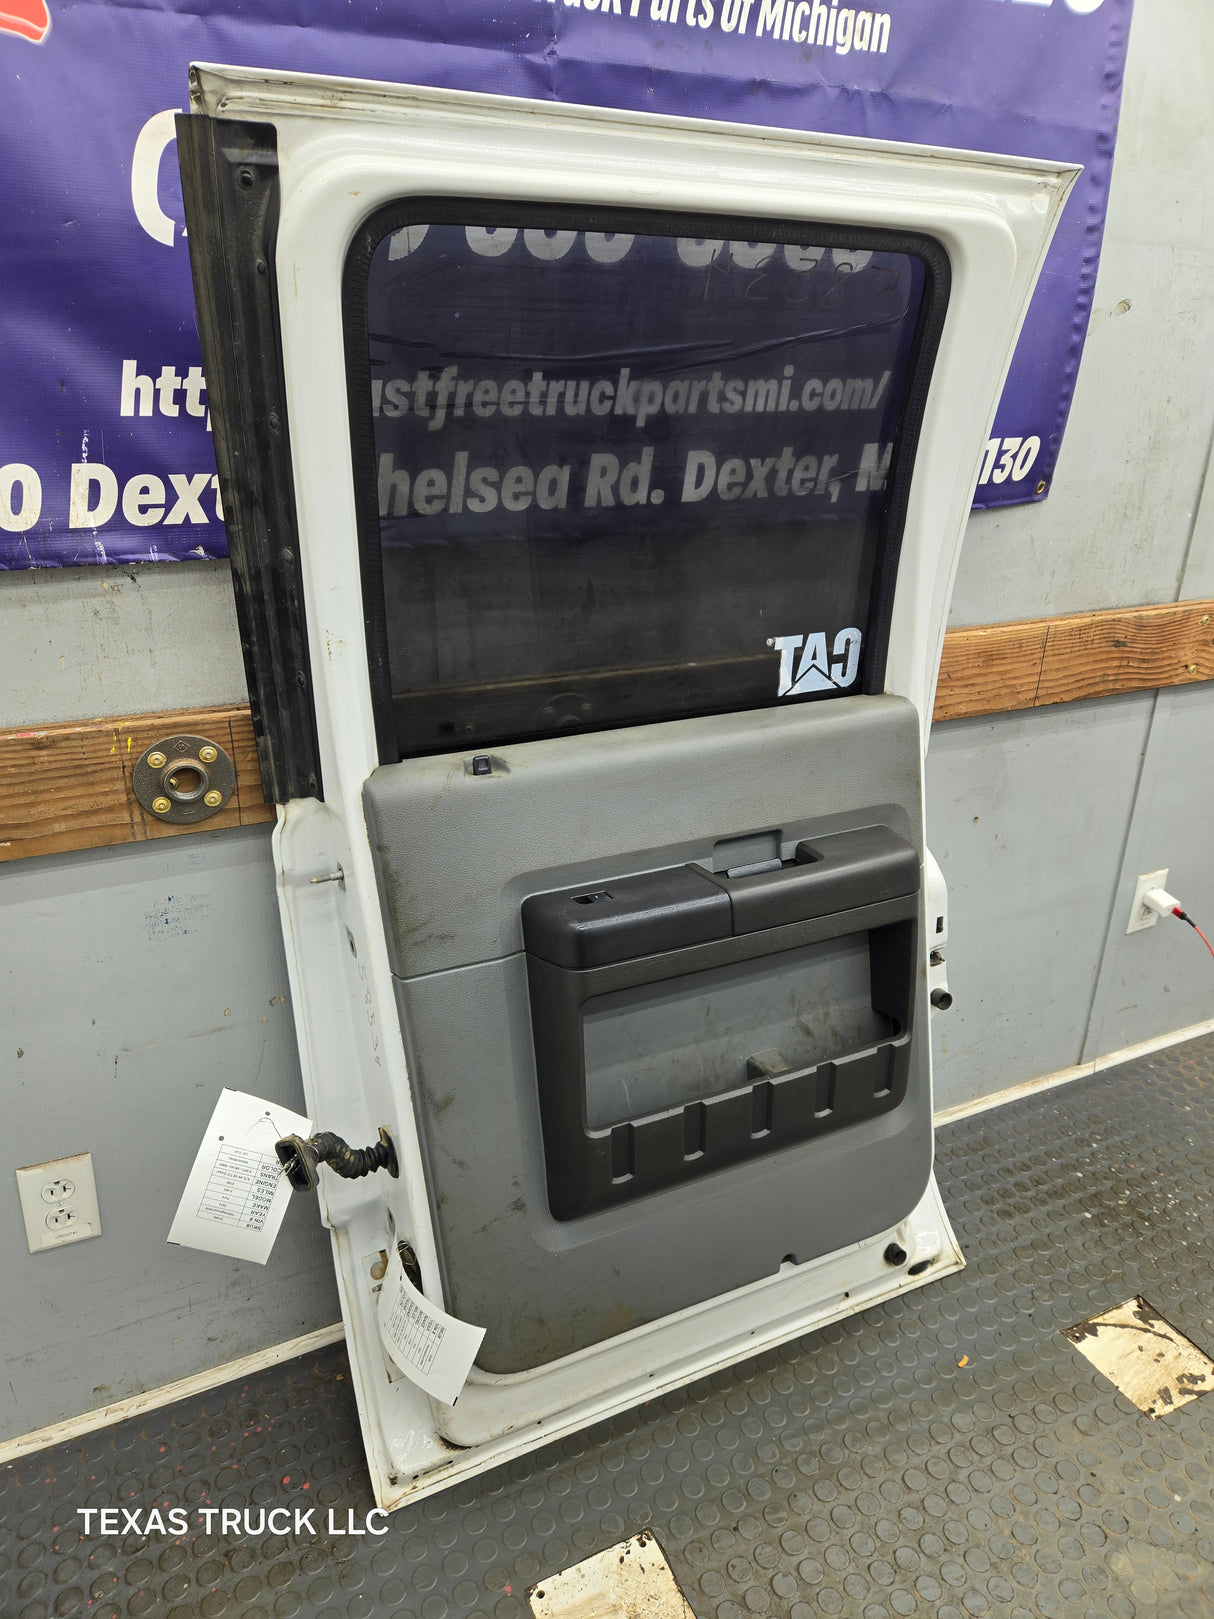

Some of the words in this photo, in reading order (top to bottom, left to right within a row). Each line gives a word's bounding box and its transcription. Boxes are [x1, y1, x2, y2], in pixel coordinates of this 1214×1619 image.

[755, 0, 891, 55] Michigan
[119, 359, 213, 432] htt
[377, 451, 570, 517] helsea
[584, 446, 664, 505] Rd.
[681, 446, 839, 503] Dexter,
[855, 442, 893, 491] M
[978, 435, 1041, 485] 130
